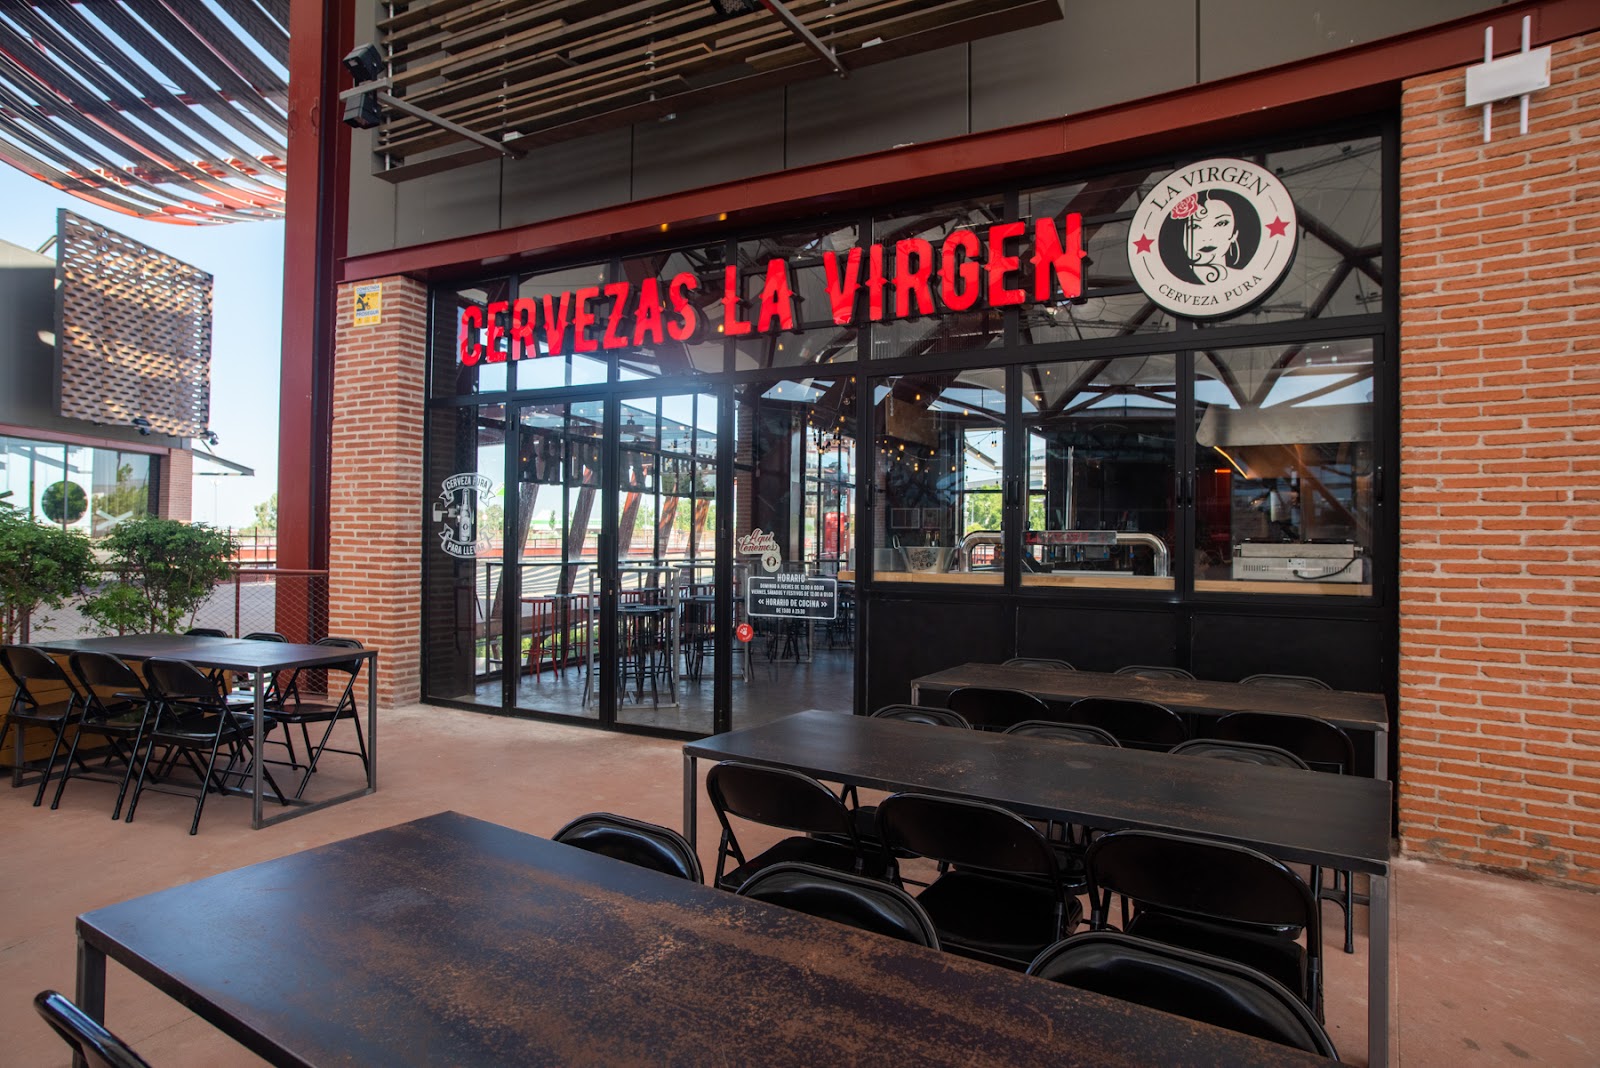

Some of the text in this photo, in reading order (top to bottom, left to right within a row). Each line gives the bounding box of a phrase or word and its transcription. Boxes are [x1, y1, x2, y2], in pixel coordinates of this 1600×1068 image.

[1151, 166, 1271, 212] LA VIRGEN
[460, 212, 1087, 367] CERVEZAS LA VIRGEN
[1158, 275, 1263, 306] CERVEZA PURA
[446, 476, 488, 490] CERVEZA PURA
[446, 541, 486, 556] PARA LLEVAR
[777, 573, 806, 583] HORARIO
[765, 598, 789, 606] HORARIO
[790, 599, 798, 607] DE
[798, 599, 820, 608] COCINA
